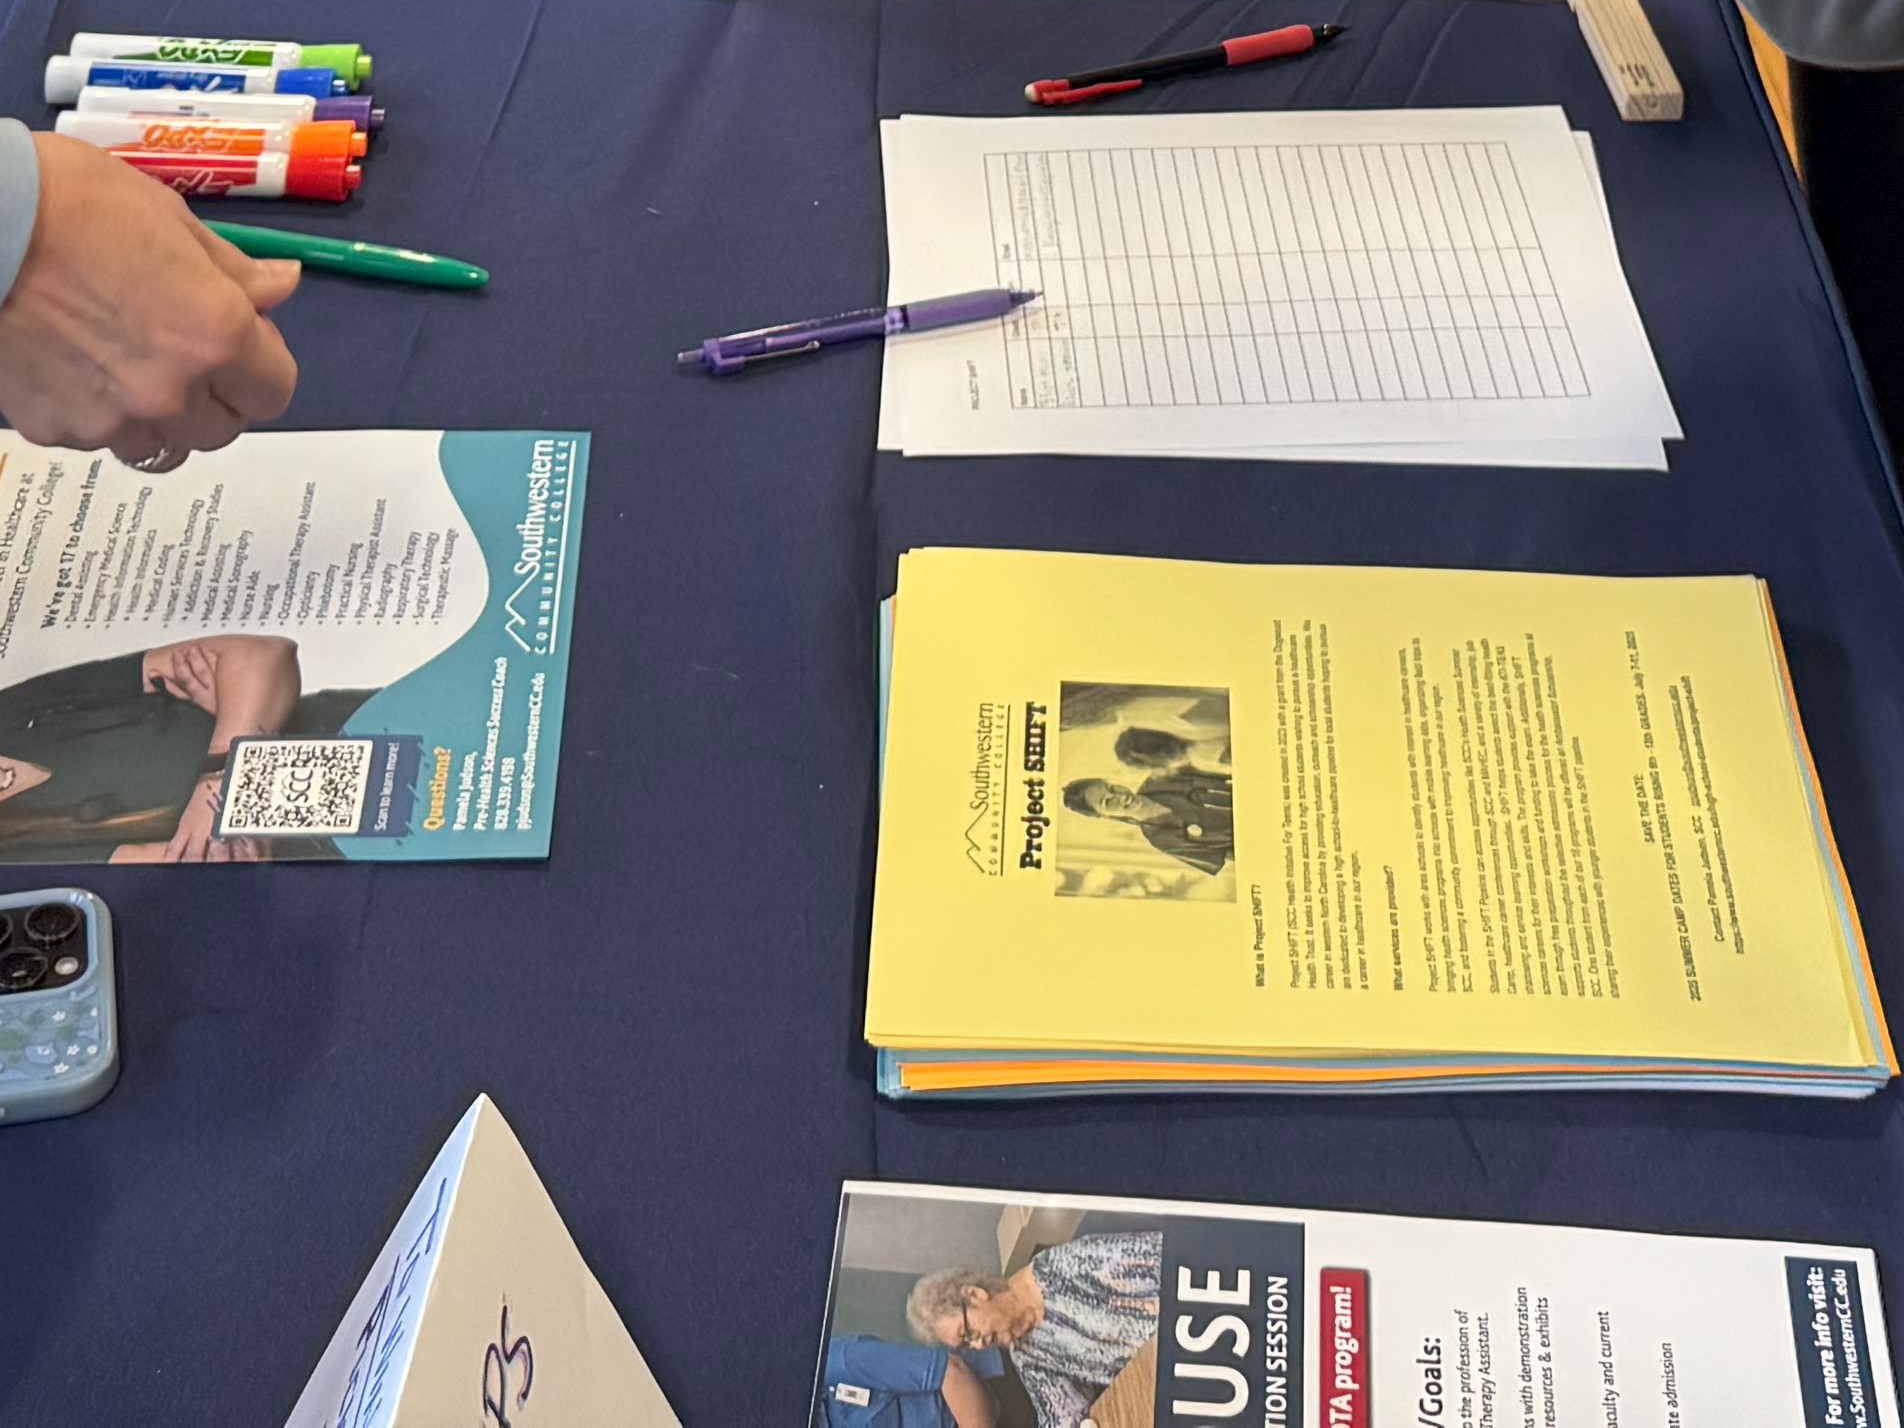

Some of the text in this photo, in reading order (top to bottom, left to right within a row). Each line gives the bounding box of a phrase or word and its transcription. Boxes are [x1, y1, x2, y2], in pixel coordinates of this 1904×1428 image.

[19, 472, 35, 485] at
[68, 492, 93, 533] choose
[514, 439, 553, 574] Southwestern
[15, 508, 52, 574] Community
[55, 566, 72, 588] got
[58, 550, 75, 564] 17
[64, 534, 80, 549] to
[219, 529, 253, 621] Medical Sonography
[277, 481, 316, 619] Occupational Therapy Assistant
[334, 542, 364, 618] Practical Nursing
[353, 498, 386, 618] Physical Therapist Assistant
[392, 531, 421, 618] Respiratory Therapy
[411, 531, 440, 619] Surgical Technology
[534, 440, 569, 654] COMMUNITY COLLEGE
[40, 590, 65, 628] We've
[238, 570, 260, 620] Nurse Aide
[257, 582, 280, 620] Nursing
[296, 570, 320, 619] Opticianry
[315, 563, 340, 618] Phlebotomy
[373, 562, 398, 618] Radiography
[473, 656, 507, 830] Pre-Health Sciences Success Coach
[969, 702, 993, 809] Southwestern
[282, 769, 313, 803] SCC
[373, 741, 399, 831] Scan to learn more!
[422, 746, 451, 830] Questions?
[452, 750, 477, 830] Pamela Judson,
[987, 703, 1005, 876] COMMUNITY COLLEGE
[1019, 701, 1050, 869] Project SHIFT
[1250, 883, 1265, 987] What is Project SHIFT?
[1173, 1266, 1251, 1428] USE
[1266, 1276, 1288, 1372] SESSION
[1329, 1286, 1360, 1391] program!
[1453, 1308, 1469, 1323] of
[1514, 1286, 1533, 1387] demonstration
[1597, 1310, 1613, 1360] current
[1806, 1265, 1845, 1426] For more info visit:
[1416, 1336, 1445, 1428] /Goals:
[1454, 1325, 1476, 1394] profession
[1477, 1312, 1496, 1428] Therapy Assistant.
[1534, 1297, 1556, 1428] resources & exhibits
[1598, 1362, 1614, 1389] and
[1661, 1342, 1679, 1409] admission
[1457, 1396, 1473, 1419] the
[1517, 1388, 1534, 1415] with
